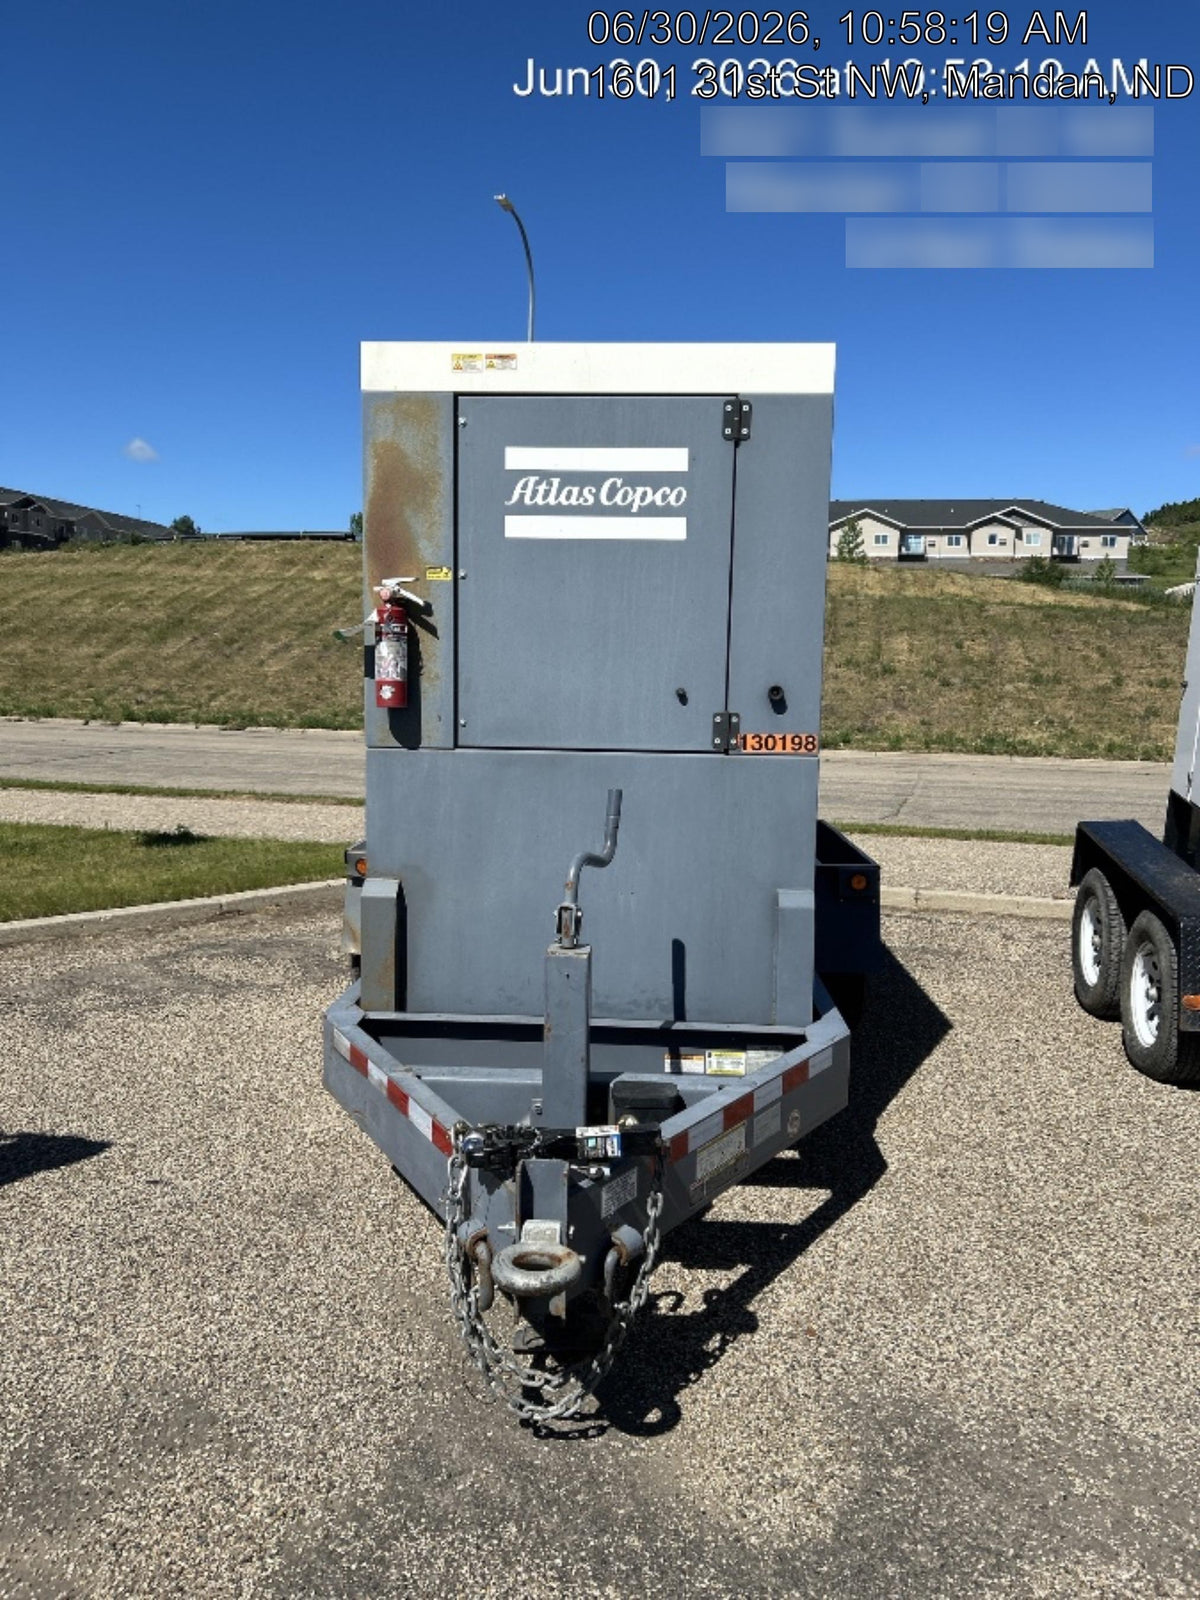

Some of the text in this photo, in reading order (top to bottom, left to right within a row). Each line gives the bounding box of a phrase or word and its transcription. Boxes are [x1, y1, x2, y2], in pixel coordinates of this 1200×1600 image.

[505, 475, 687, 512] Atlas Copco
[740, 733, 817, 751] 130198
